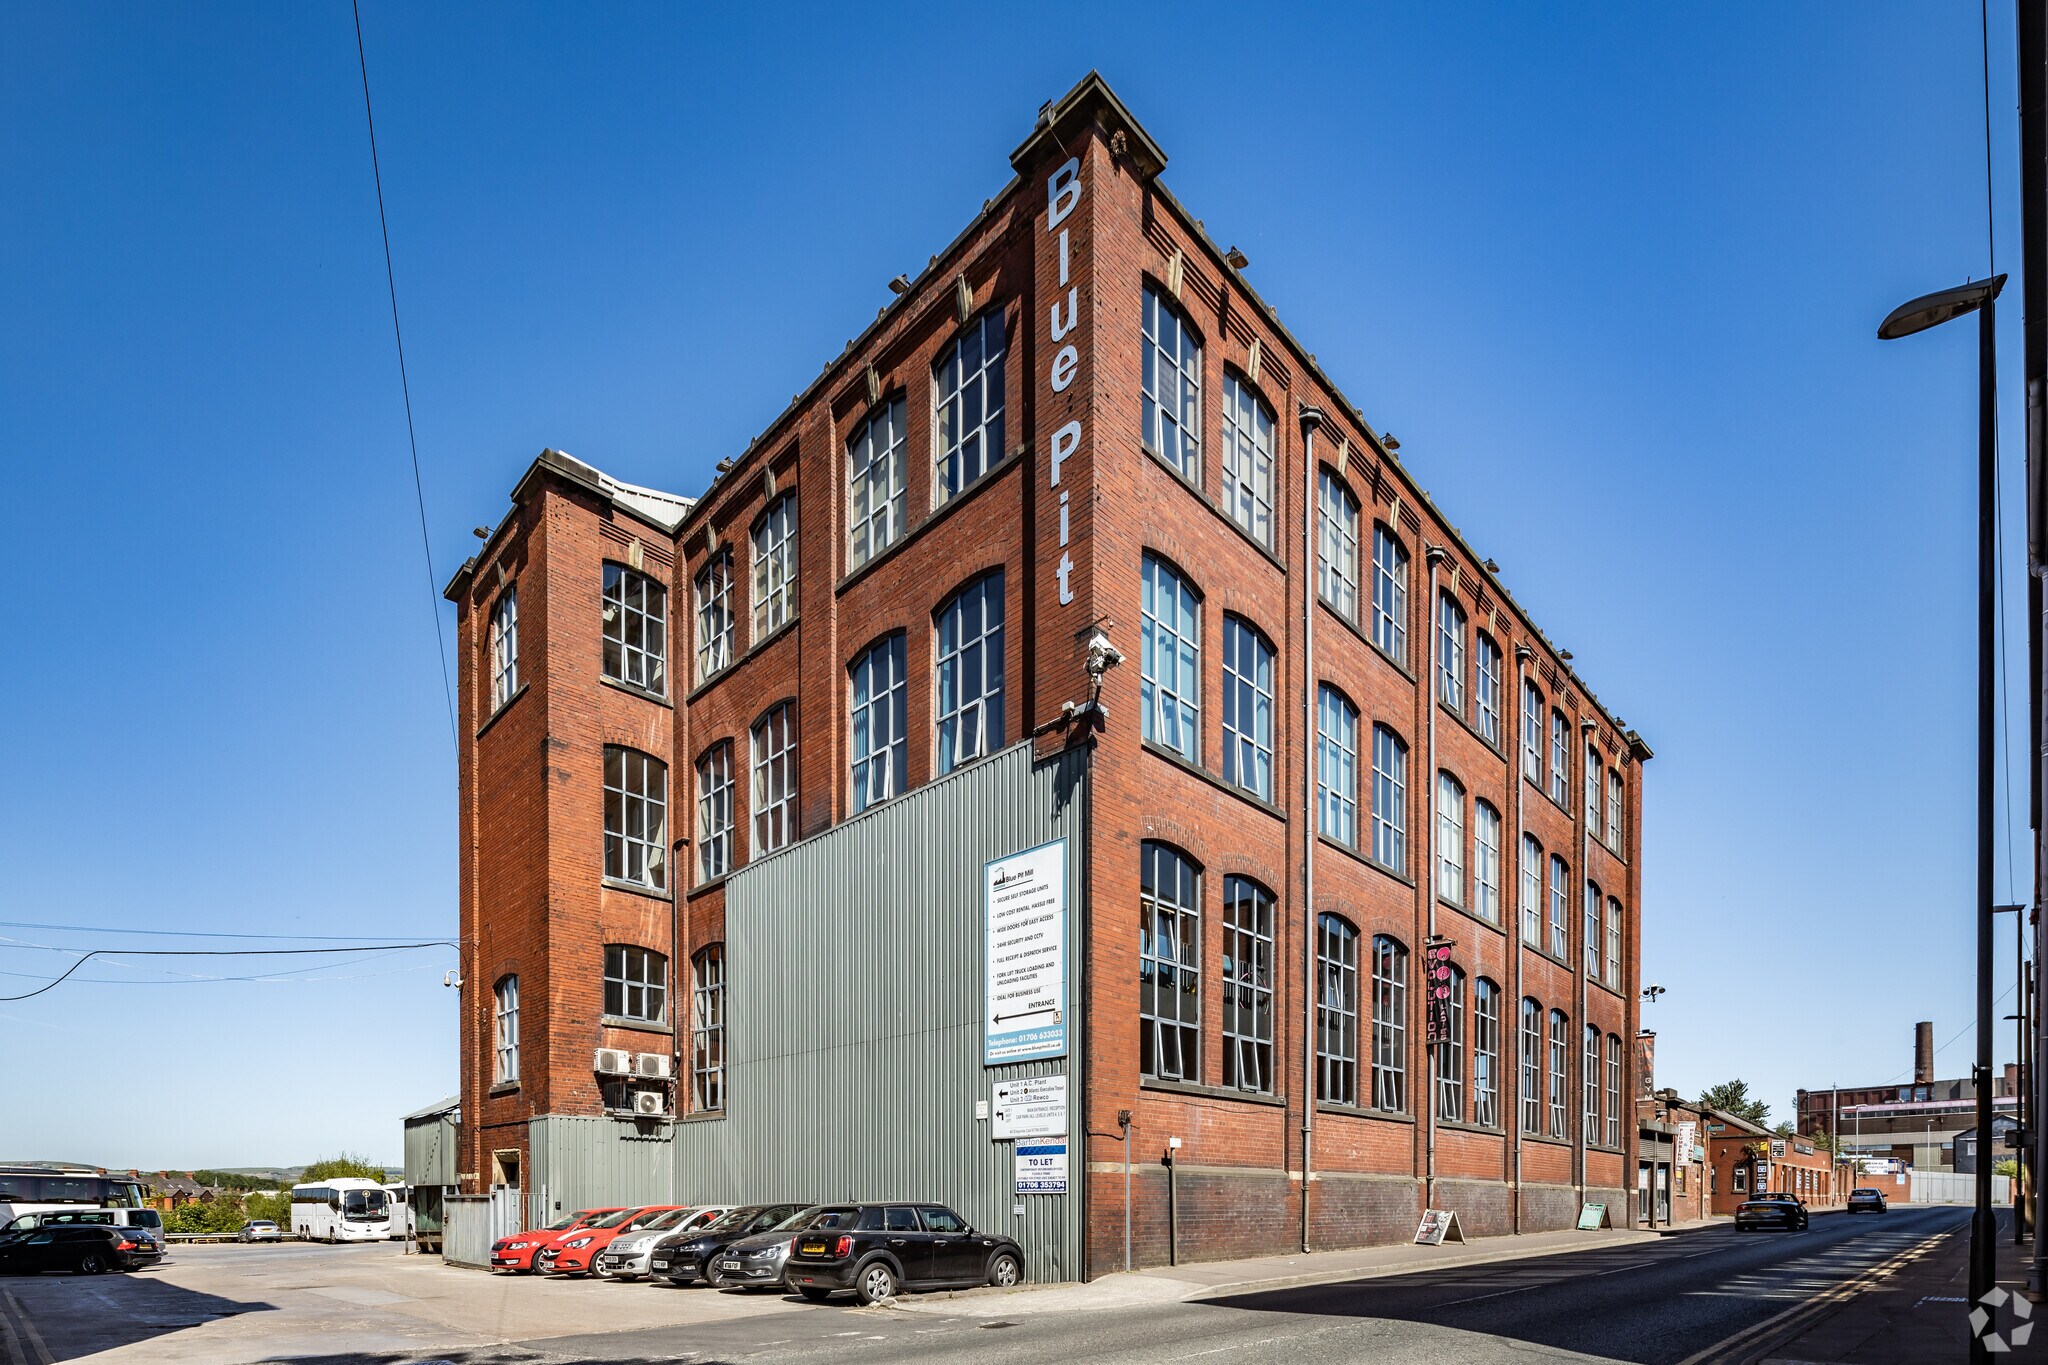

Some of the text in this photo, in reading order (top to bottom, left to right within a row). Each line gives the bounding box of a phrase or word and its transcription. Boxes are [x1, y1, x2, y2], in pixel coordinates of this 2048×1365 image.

[1047, 157, 1081, 393] Blue
[1051, 420, 1082, 605] Pit
[997, 895, 1010, 903] SECURE
[1019, 888, 1036, 897] STORAGE
[1040, 914, 1054, 922] ACCESS
[1007, 937, 1024, 946] SECURITY
[1024, 949, 1041, 957] DISPATCH
[1042, 945, 1057, 953] SERVICE
[1027, 964, 1045, 972] LOADING
[997, 973, 1037, 986] UNLOADING FACILITIES
[1016, 990, 1033, 998] BUSINESS
[1029, 999, 1055, 1009] ENTRANCE
[988, 1029, 1062, 1047] Telephone: 01706 633033
[1644, 1077, 1652, 1100] GYM
